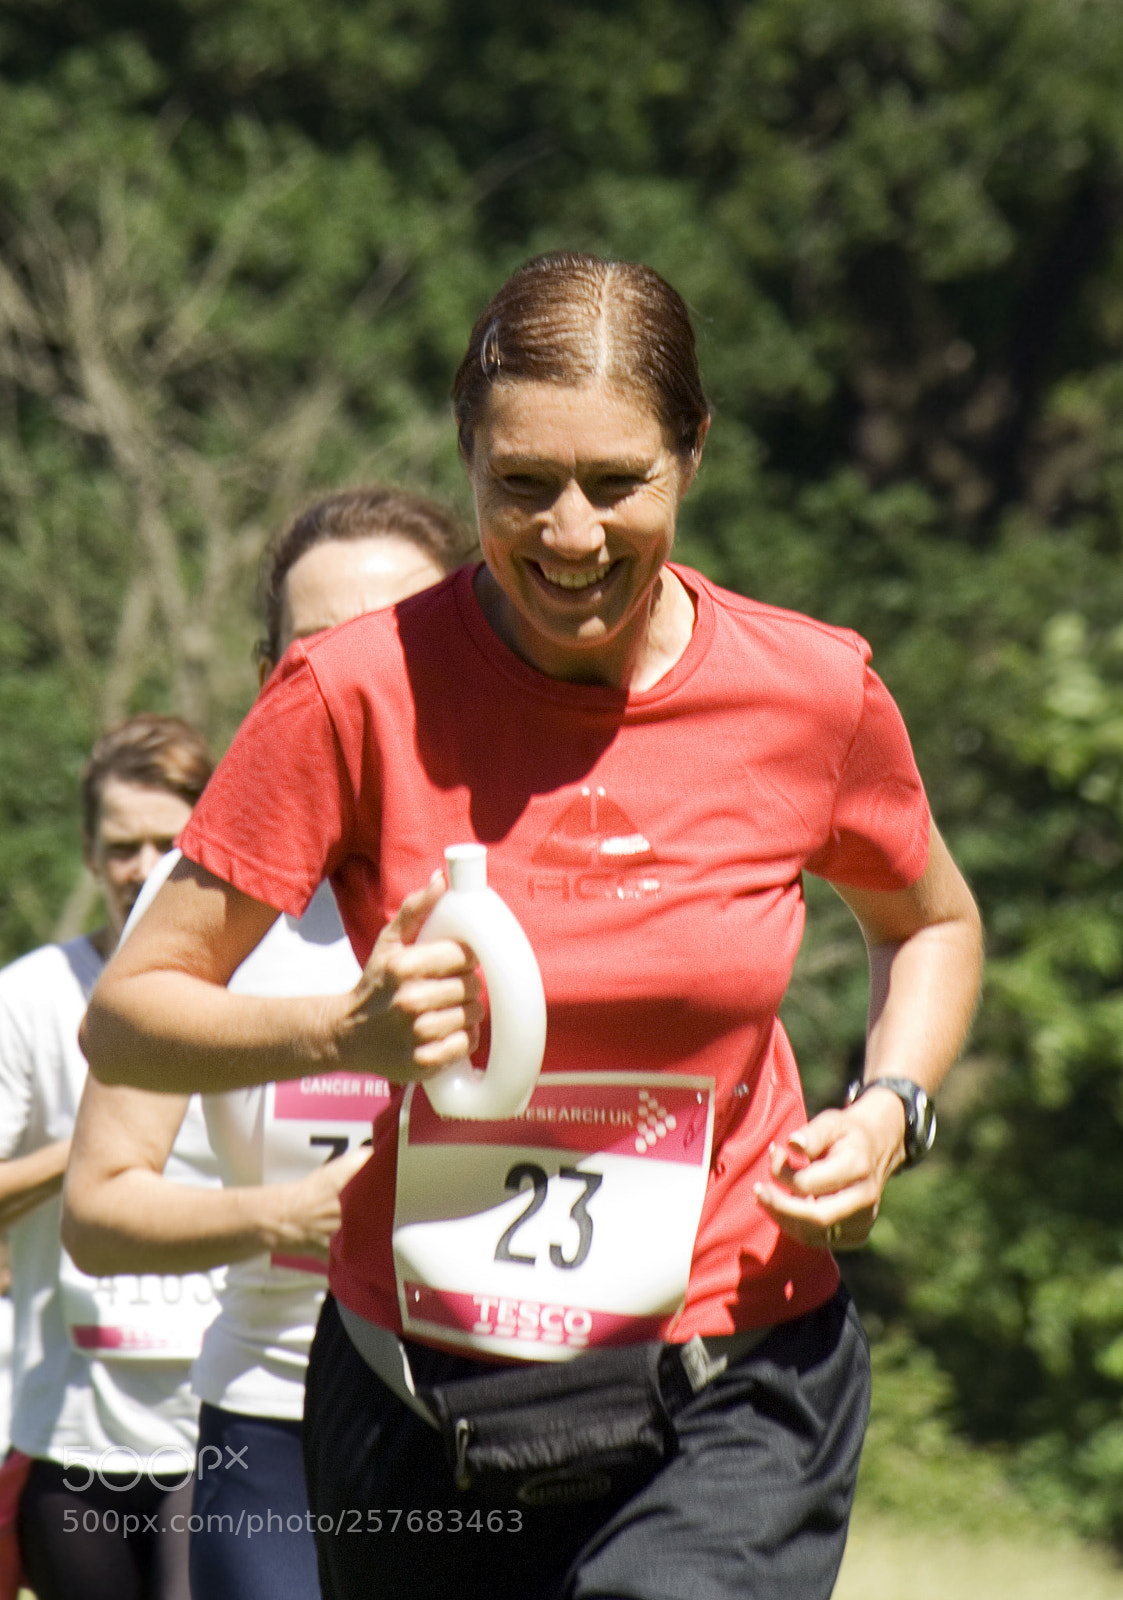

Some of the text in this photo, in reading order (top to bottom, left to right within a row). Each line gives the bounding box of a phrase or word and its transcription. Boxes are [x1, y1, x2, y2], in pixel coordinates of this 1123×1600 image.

[301, 1077, 361, 1096] CANCER
[609, 1108, 634, 1126] UK
[494, 1162, 603, 1269] 23
[472, 1295, 593, 1340] TESCO
